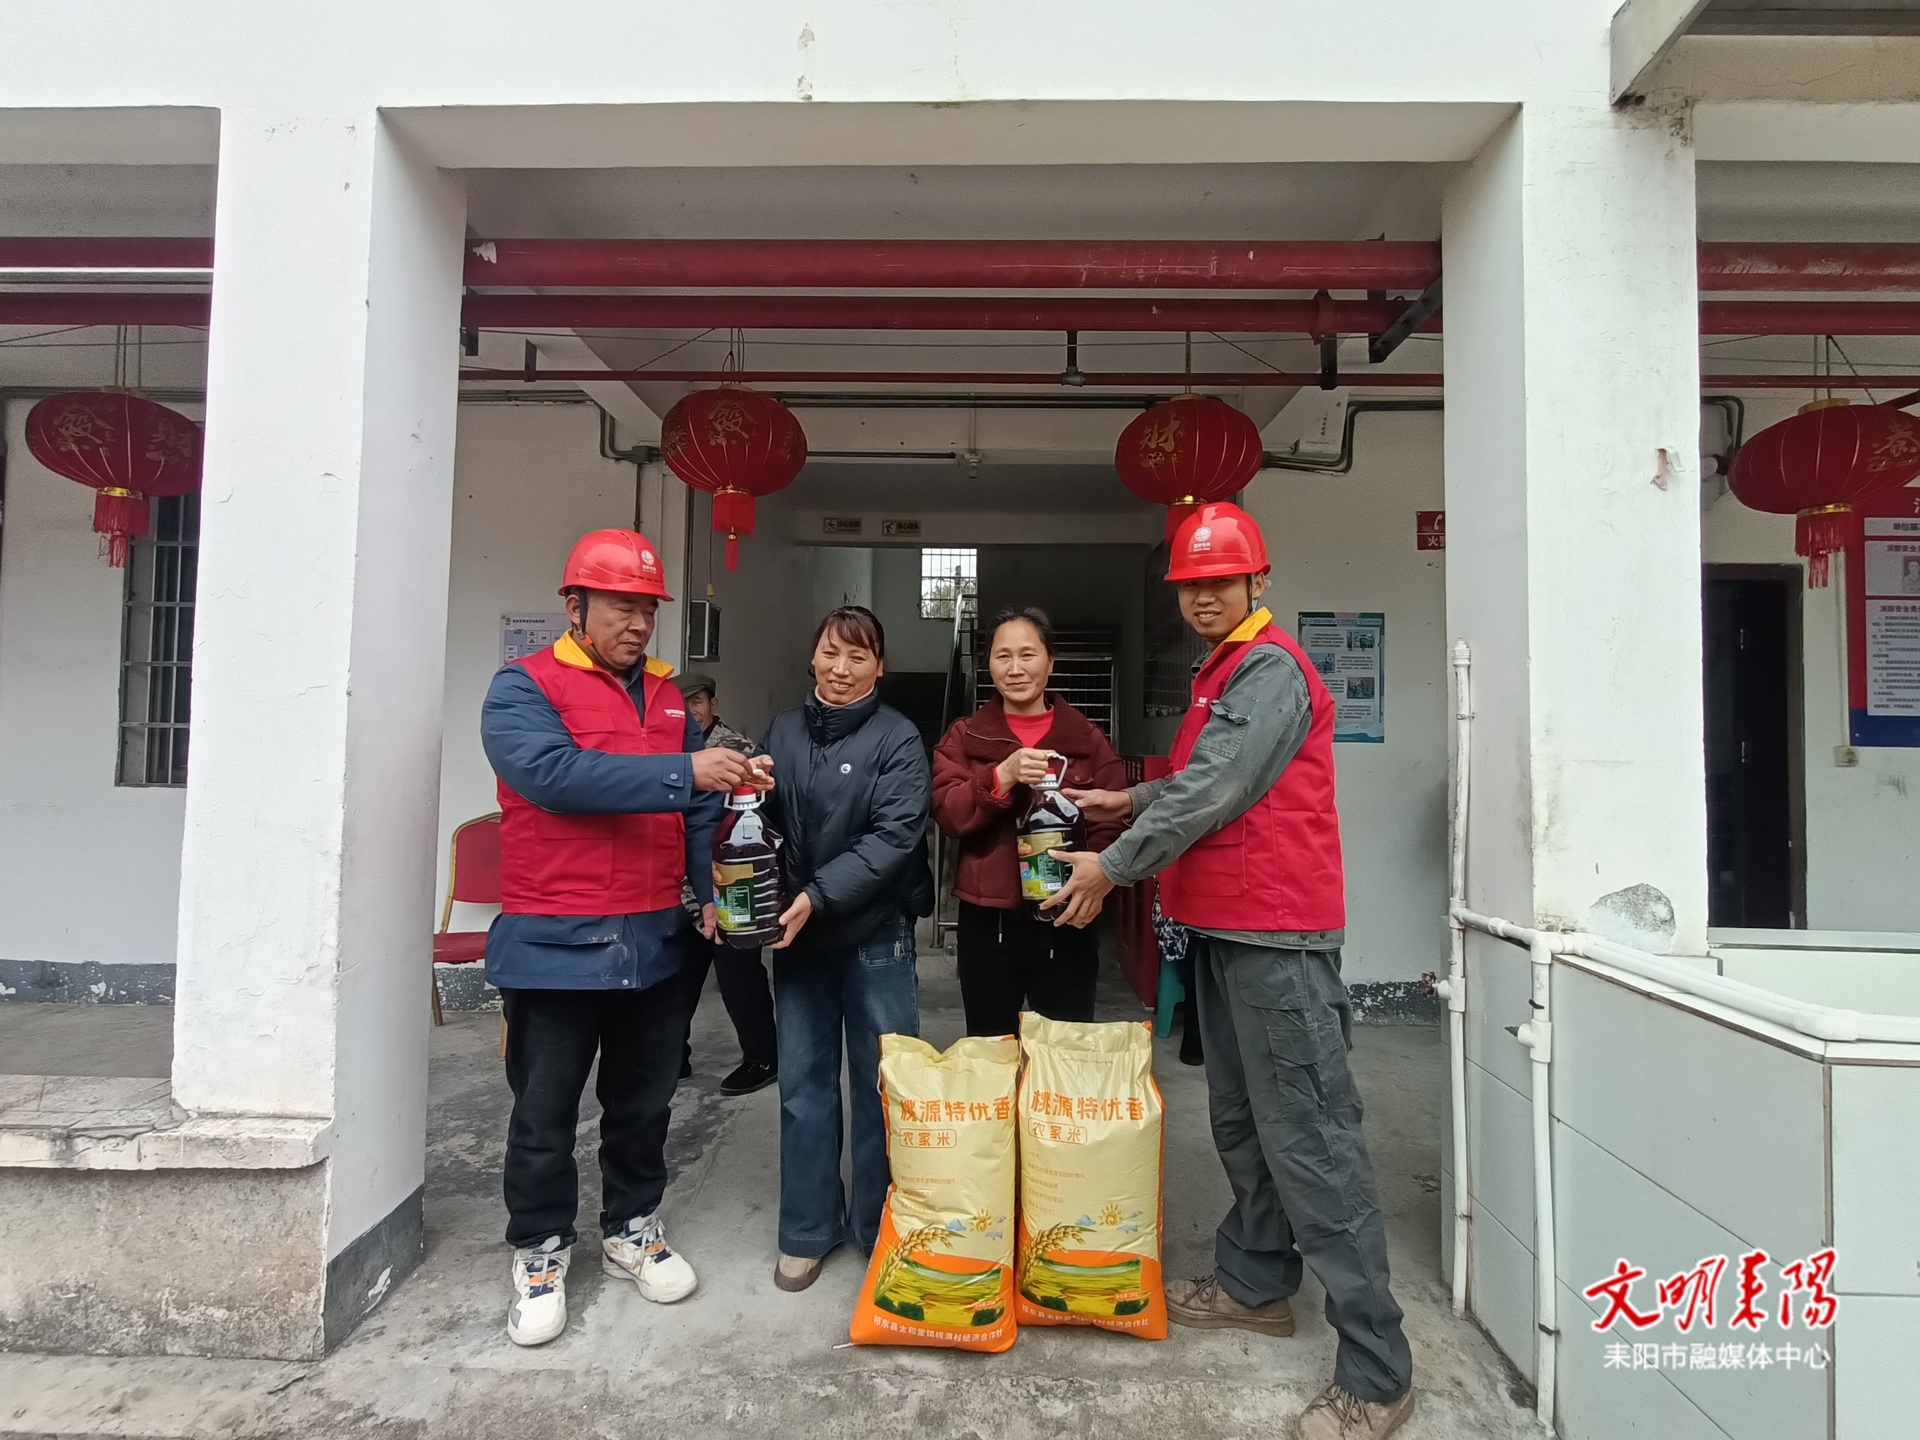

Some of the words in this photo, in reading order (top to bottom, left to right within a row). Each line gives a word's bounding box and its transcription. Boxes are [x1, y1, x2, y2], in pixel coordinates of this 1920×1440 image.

[900, 1096, 1012, 1123] 桃源特优香
[1031, 1090, 1145, 1121] 桃源特优香
[903, 1131, 950, 1147] 农家米
[1032, 1121, 1081, 1142] 农家米
